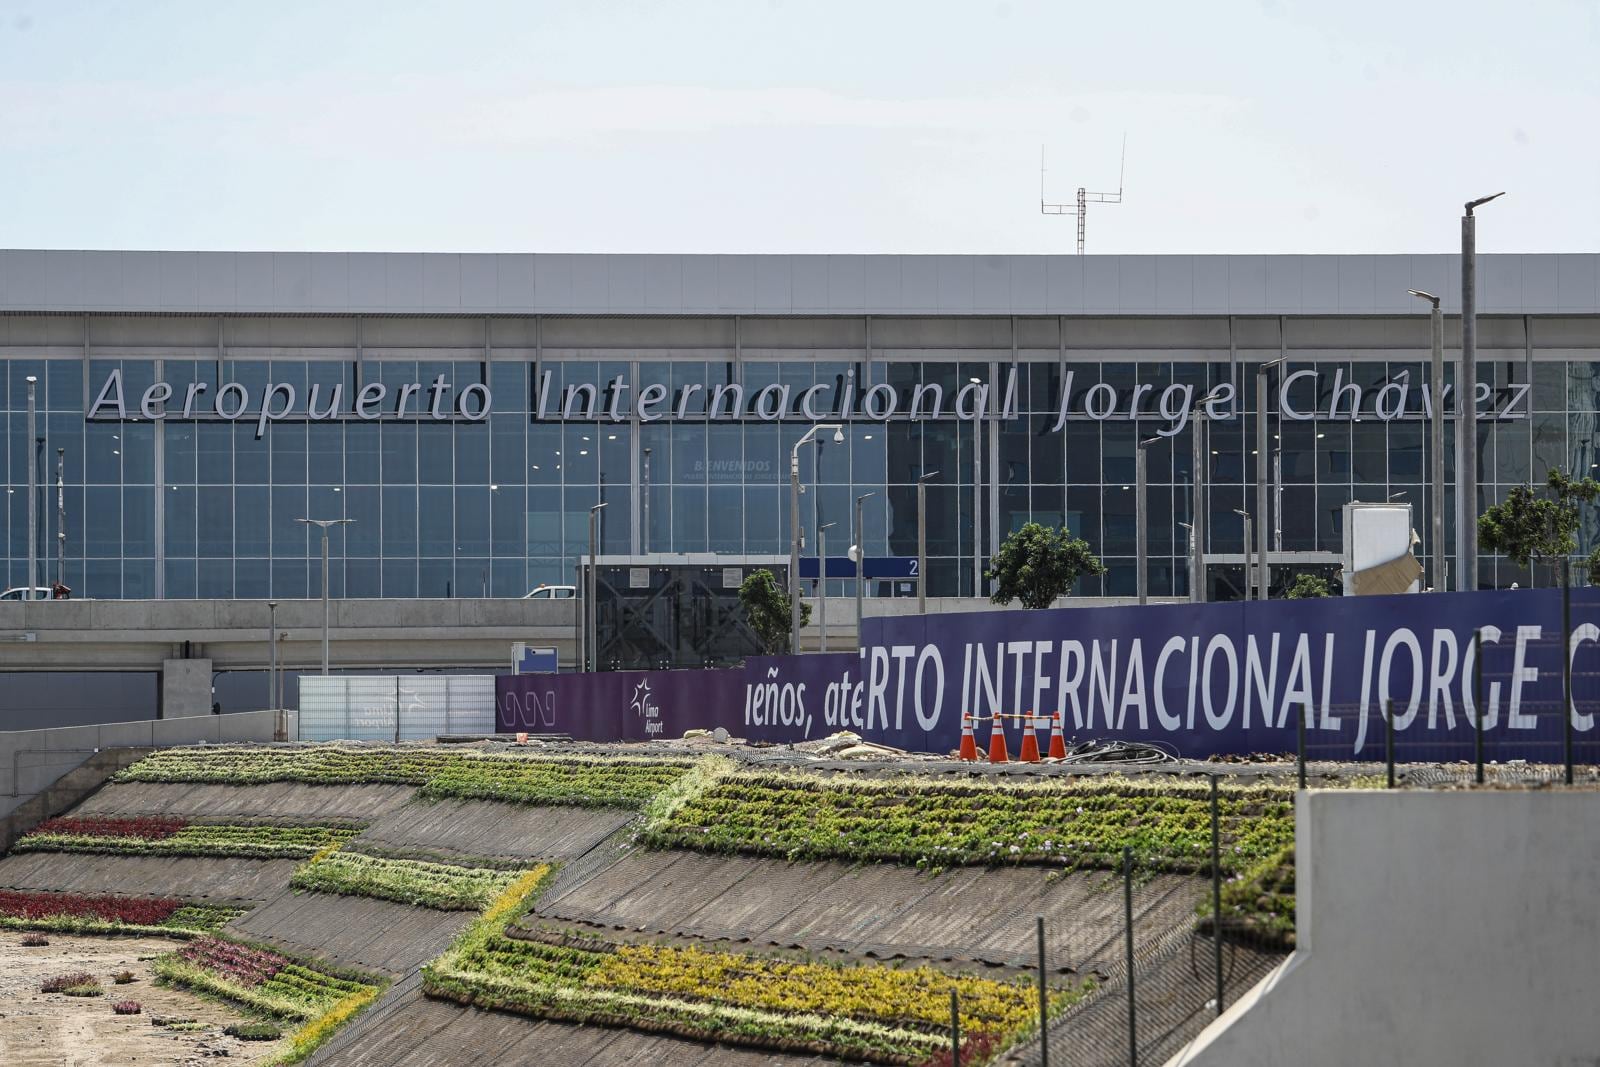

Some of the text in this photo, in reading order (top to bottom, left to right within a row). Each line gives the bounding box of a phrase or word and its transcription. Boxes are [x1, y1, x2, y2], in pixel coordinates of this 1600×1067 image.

[88, 368, 492, 436] Aeropuerto
[537, 367, 1017, 421] Internacional
[1052, 370, 1235, 437] Jorge
[909, 559, 919, 576] 2
[645, 703, 659, 718] Lima
[745, 666, 813, 740] eños,
[860, 643, 945, 731] RTO
[961, 632, 1341, 731] INTERNACIONAL
[1354, 624, 1542, 755] JORGE
[645, 721, 664, 737] Airport
